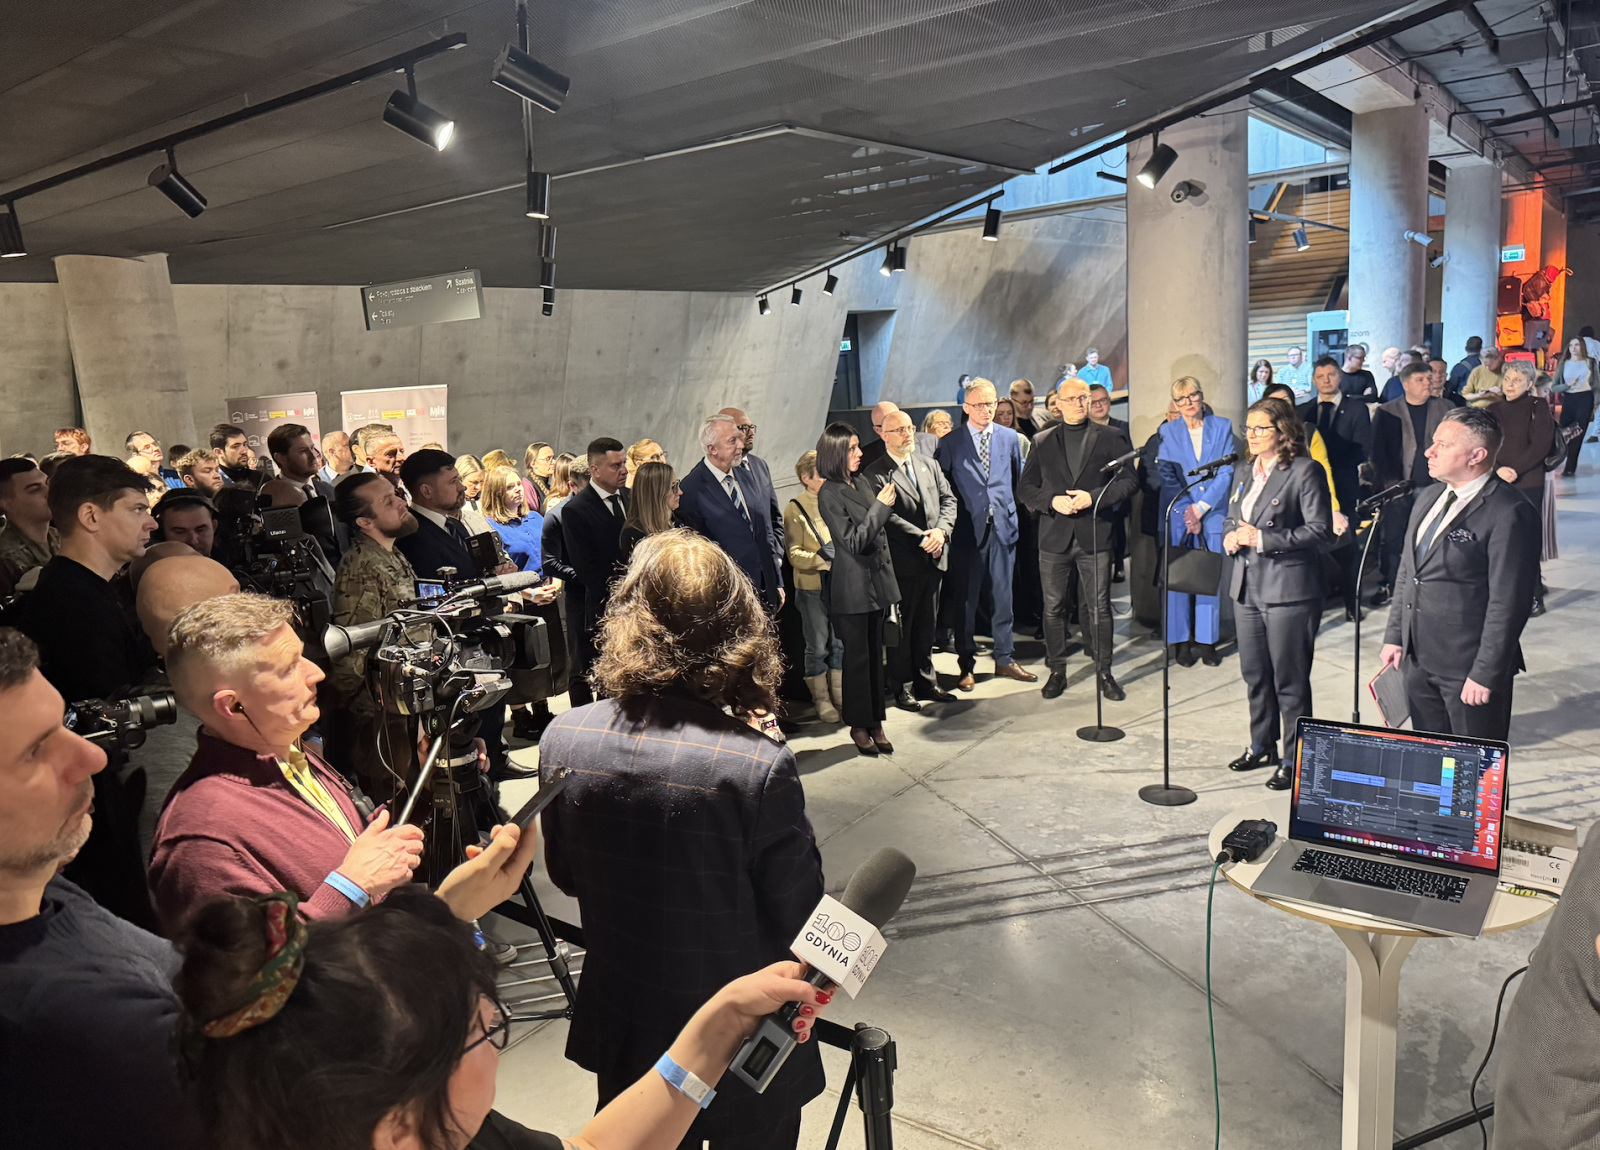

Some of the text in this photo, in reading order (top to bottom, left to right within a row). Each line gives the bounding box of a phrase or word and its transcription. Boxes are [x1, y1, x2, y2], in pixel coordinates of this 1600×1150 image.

[455, 277, 474, 286] Szatnia
[805, 931, 851, 967] GDYNIA
[811, 913, 862, 952] 100
